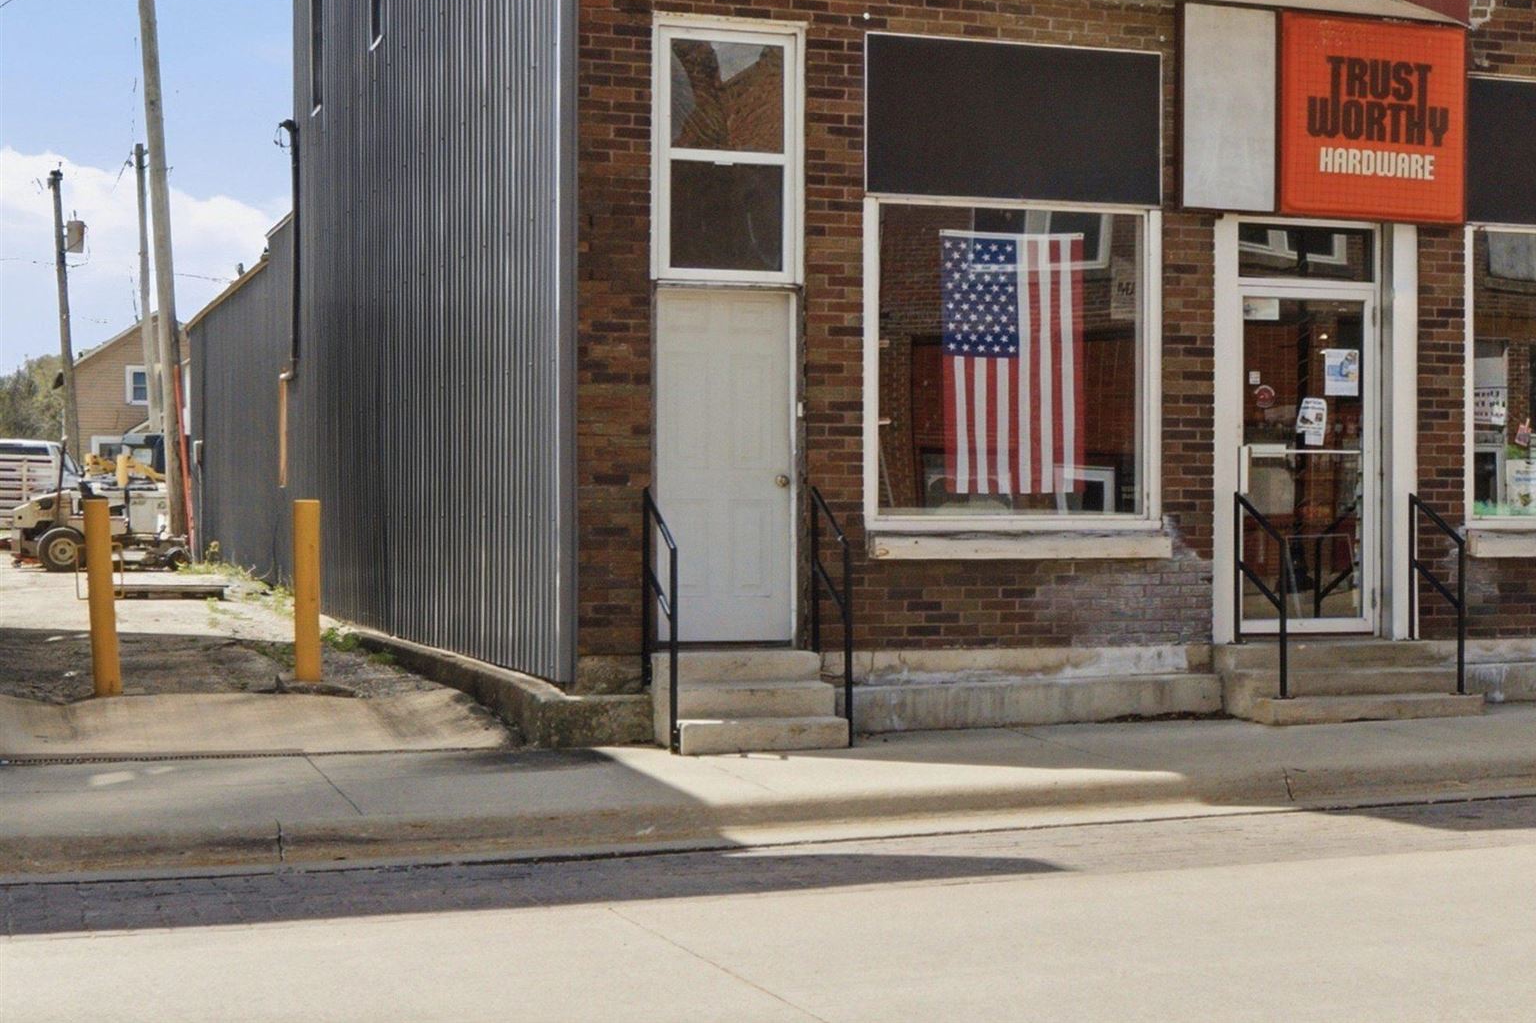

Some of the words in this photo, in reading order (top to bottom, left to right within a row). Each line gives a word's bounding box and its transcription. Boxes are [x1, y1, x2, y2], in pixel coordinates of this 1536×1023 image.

[1327, 56, 1432, 103] TRUST
[1307, 96, 1449, 146] WORTHY
[1320, 147, 1435, 180] HARDWARE
